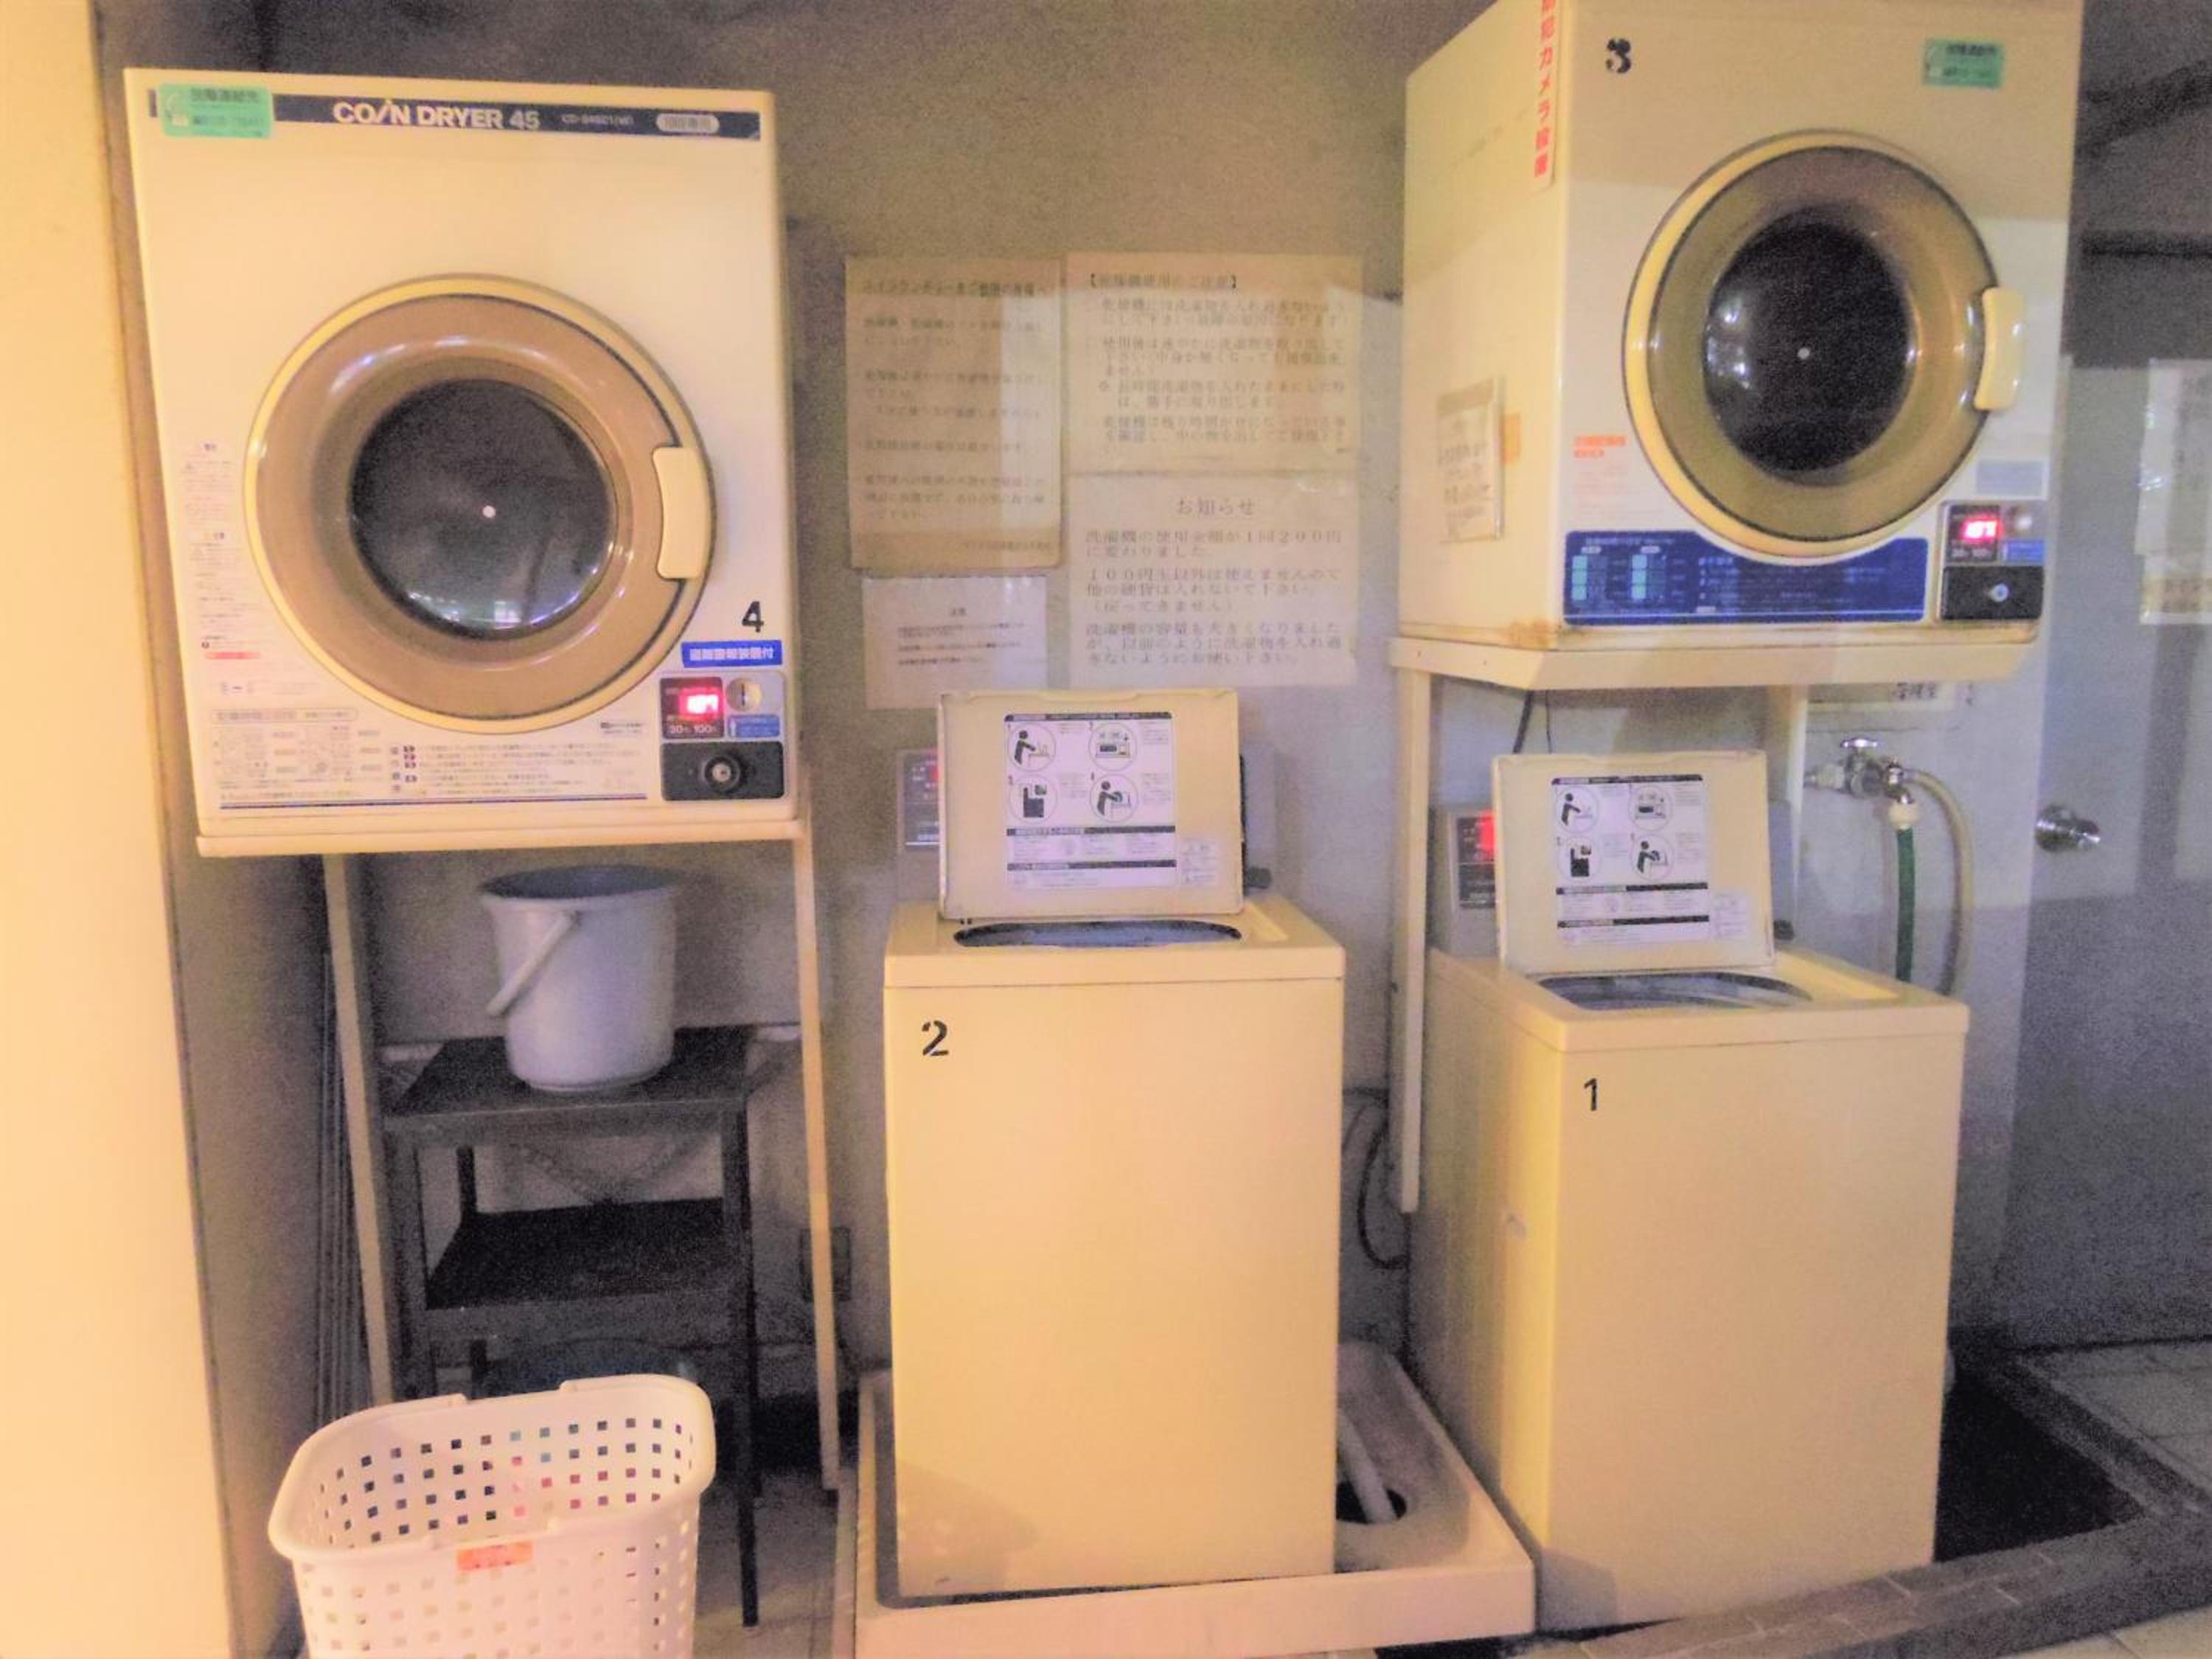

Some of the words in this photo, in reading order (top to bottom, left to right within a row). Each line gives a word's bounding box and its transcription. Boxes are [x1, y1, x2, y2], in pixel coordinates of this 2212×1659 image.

[1606, 38, 1632, 74] 3
[333, 98, 410, 125] COIN
[417, 105, 503, 129] DRYER
[509, 110, 540, 131] 45
[1177, 498, 1256, 516] お知らせ
[742, 601, 764, 633] 4
[921, 1020, 949, 1057] 2
[1583, 1078, 1598, 1111] 1
